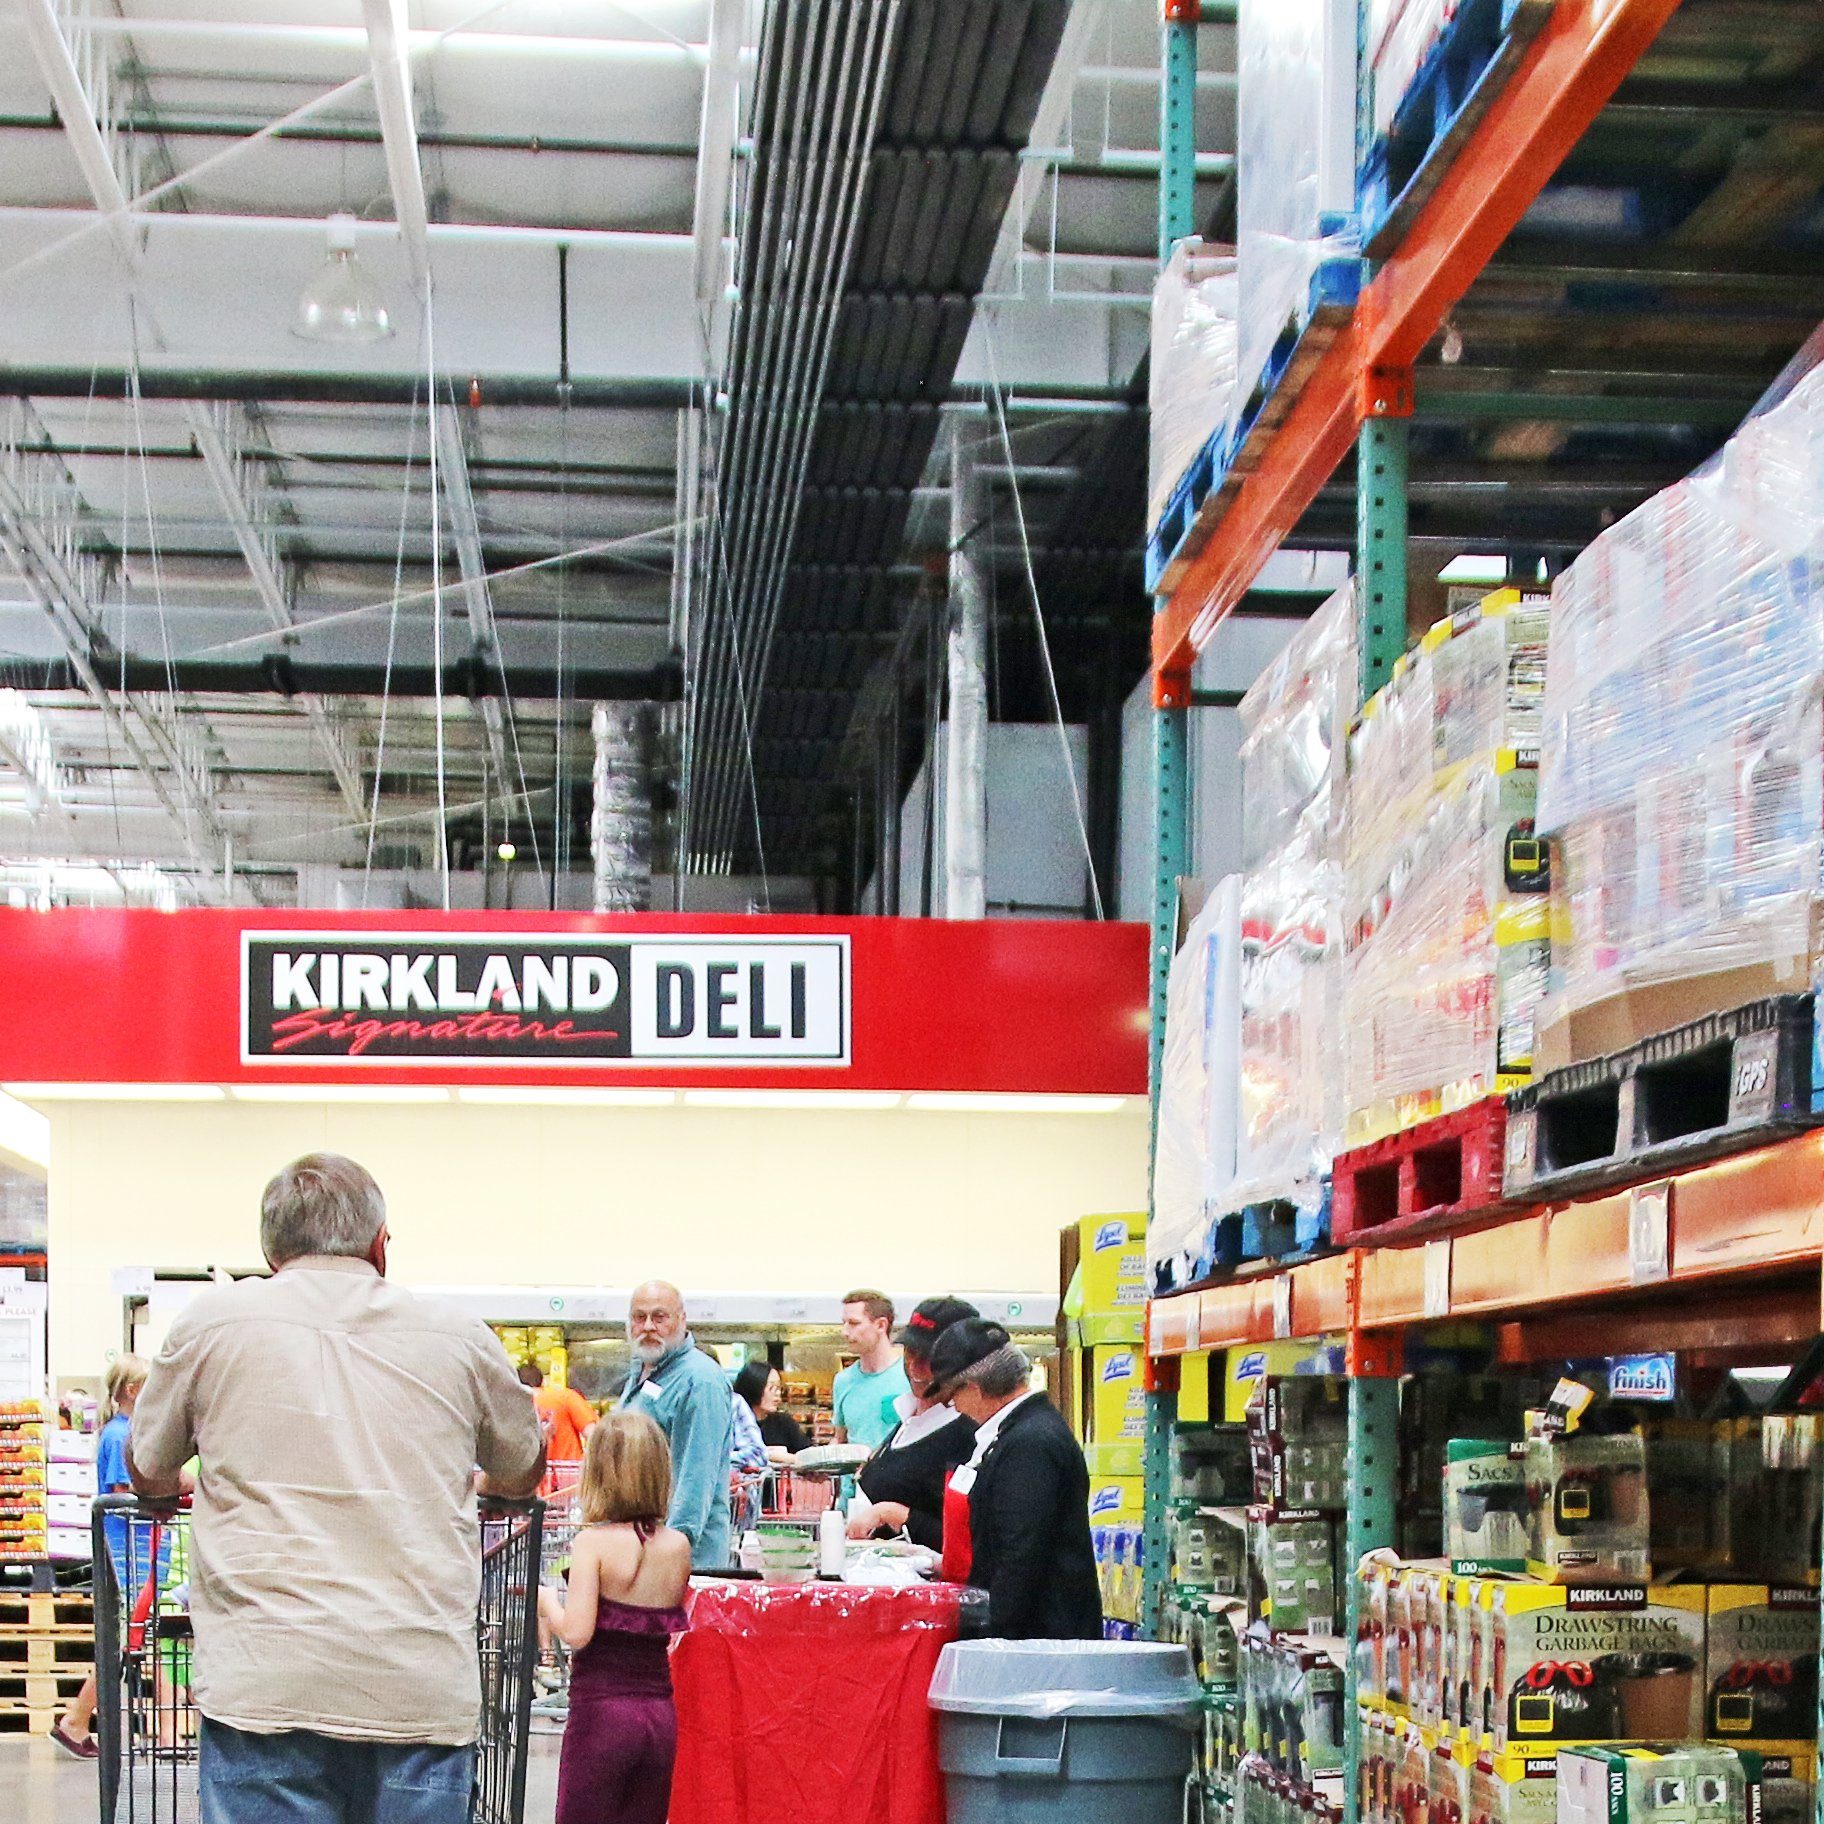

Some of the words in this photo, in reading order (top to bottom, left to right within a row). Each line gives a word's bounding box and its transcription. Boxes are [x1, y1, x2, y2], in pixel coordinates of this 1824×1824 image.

[1522, 594, 1551, 604] KIRK
[272, 953, 618, 1011] KIRKLAND
[656, 961, 806, 1038] DELI
[272, 1009, 617, 1055] Signature
[1096, 1222, 1124, 1247] Lysol
[1105, 1355, 1133, 1377] Lysol
[1613, 1368, 1667, 1390] finish
[1093, 1488, 1121, 1508] Lysol
[1279, 1510, 1319, 1518] KIRKLAND
[1457, 1561, 1477, 1574] 100
[1570, 1589, 1644, 1601] KIRKLAND
[1772, 1589, 1821, 1601] KIRKL
[1536, 1615, 1678, 1633] DRAWSTRING
[1738, 1614, 1818, 1633] DRAWS
[1536, 1636, 1624, 1651] GARBAGE
[1513, 1744, 1530, 1754] 90
[1528, 1760, 1557, 1772] KIRK
[1610, 1771, 1623, 1796] 100
